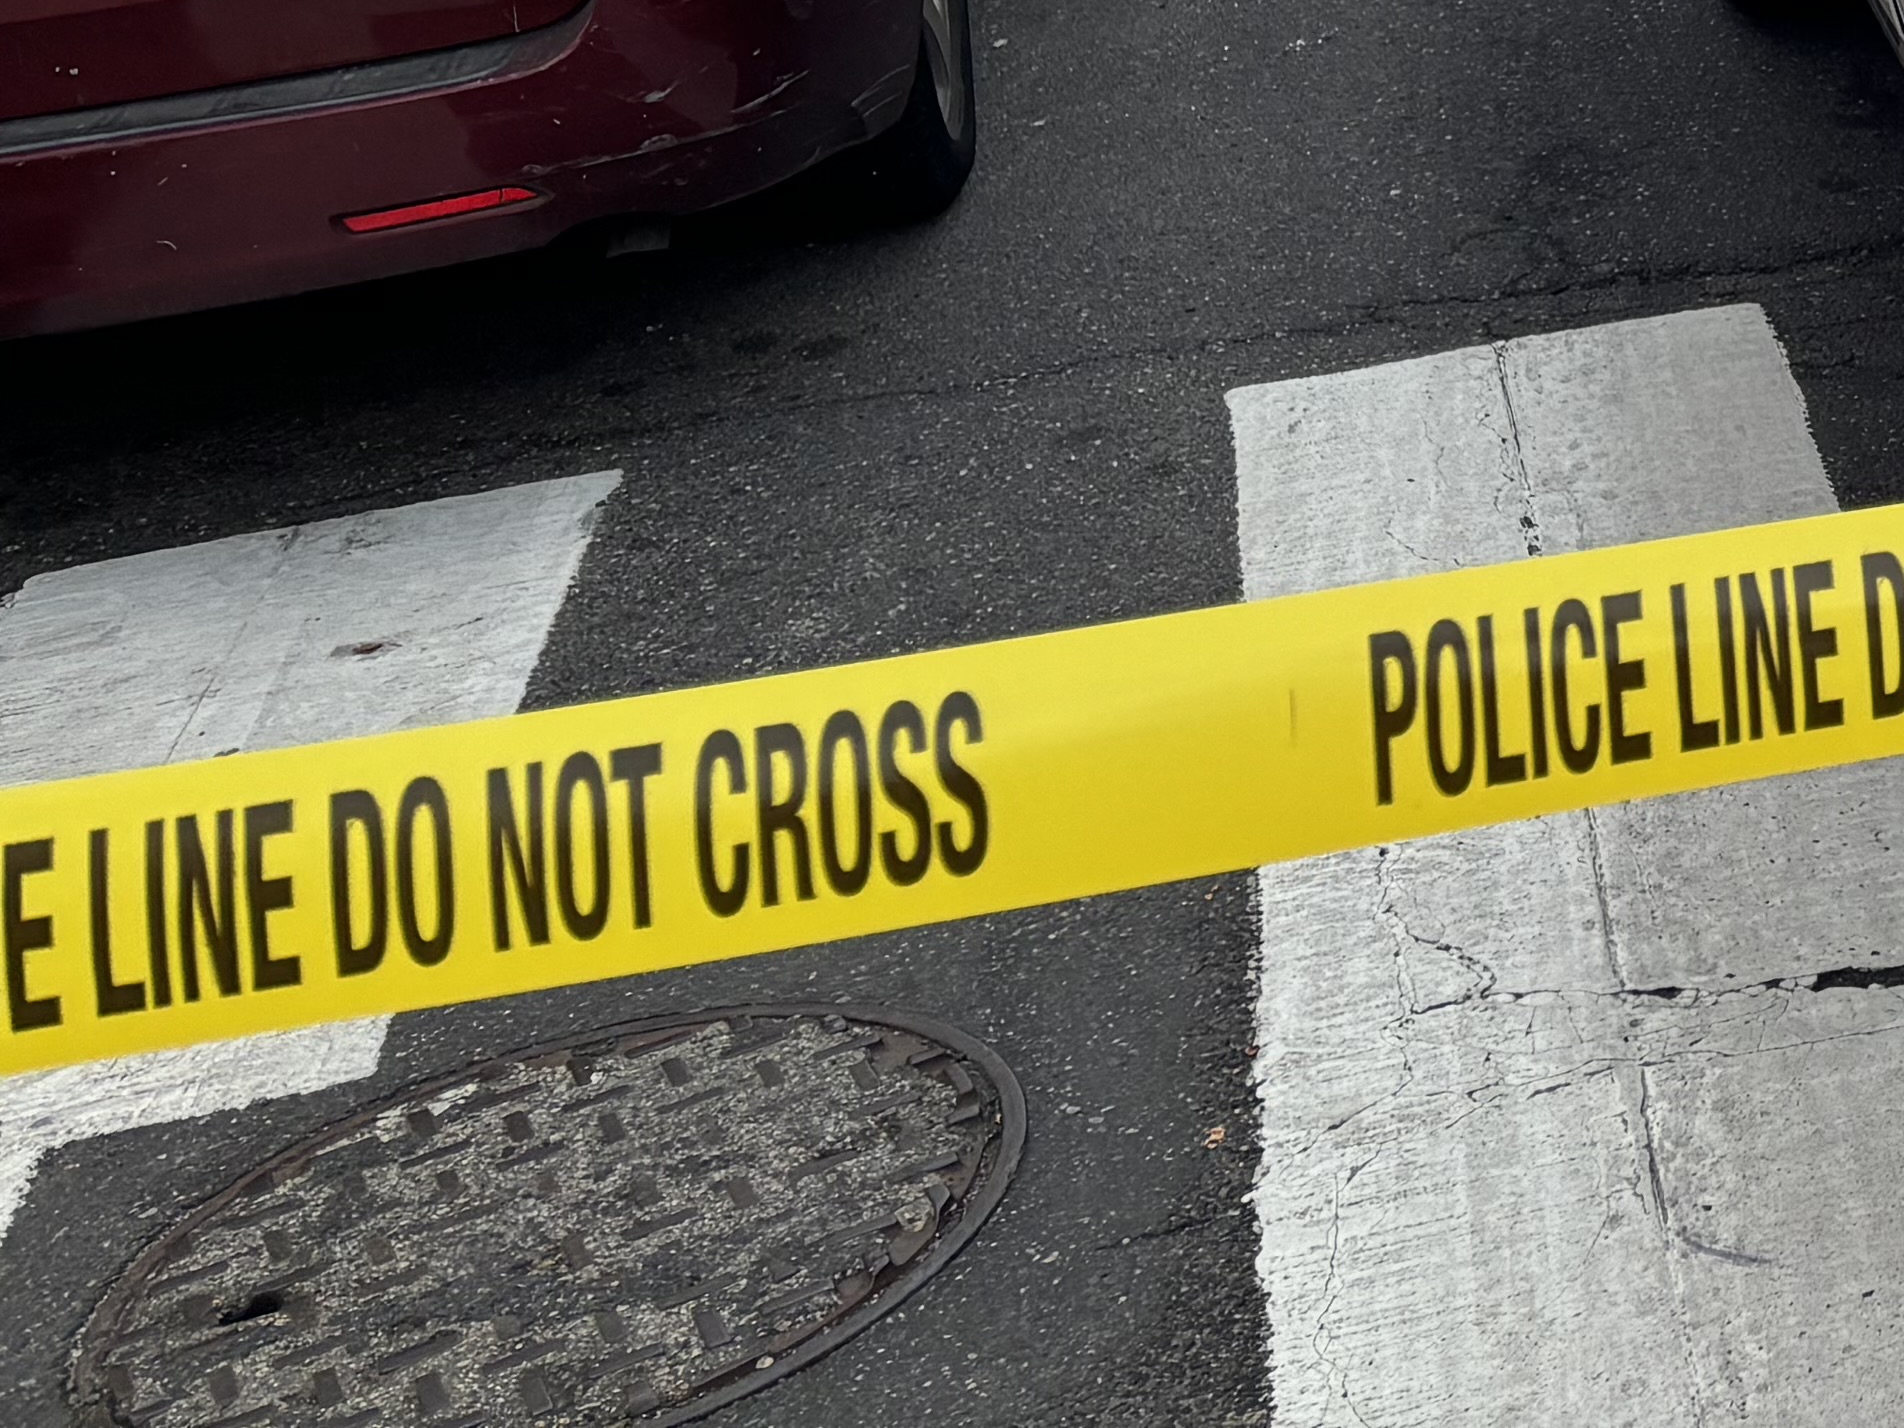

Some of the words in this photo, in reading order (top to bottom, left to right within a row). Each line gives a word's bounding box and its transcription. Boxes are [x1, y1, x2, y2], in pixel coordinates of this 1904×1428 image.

[1367, 590, 1652, 807] POLICE
[1669, 558, 1844, 755] LINE
[89, 798, 301, 1018] LINE
[328, 775, 455, 978] DO
[487, 741, 663, 952] NOT
[693, 690, 988, 919] CROSS
